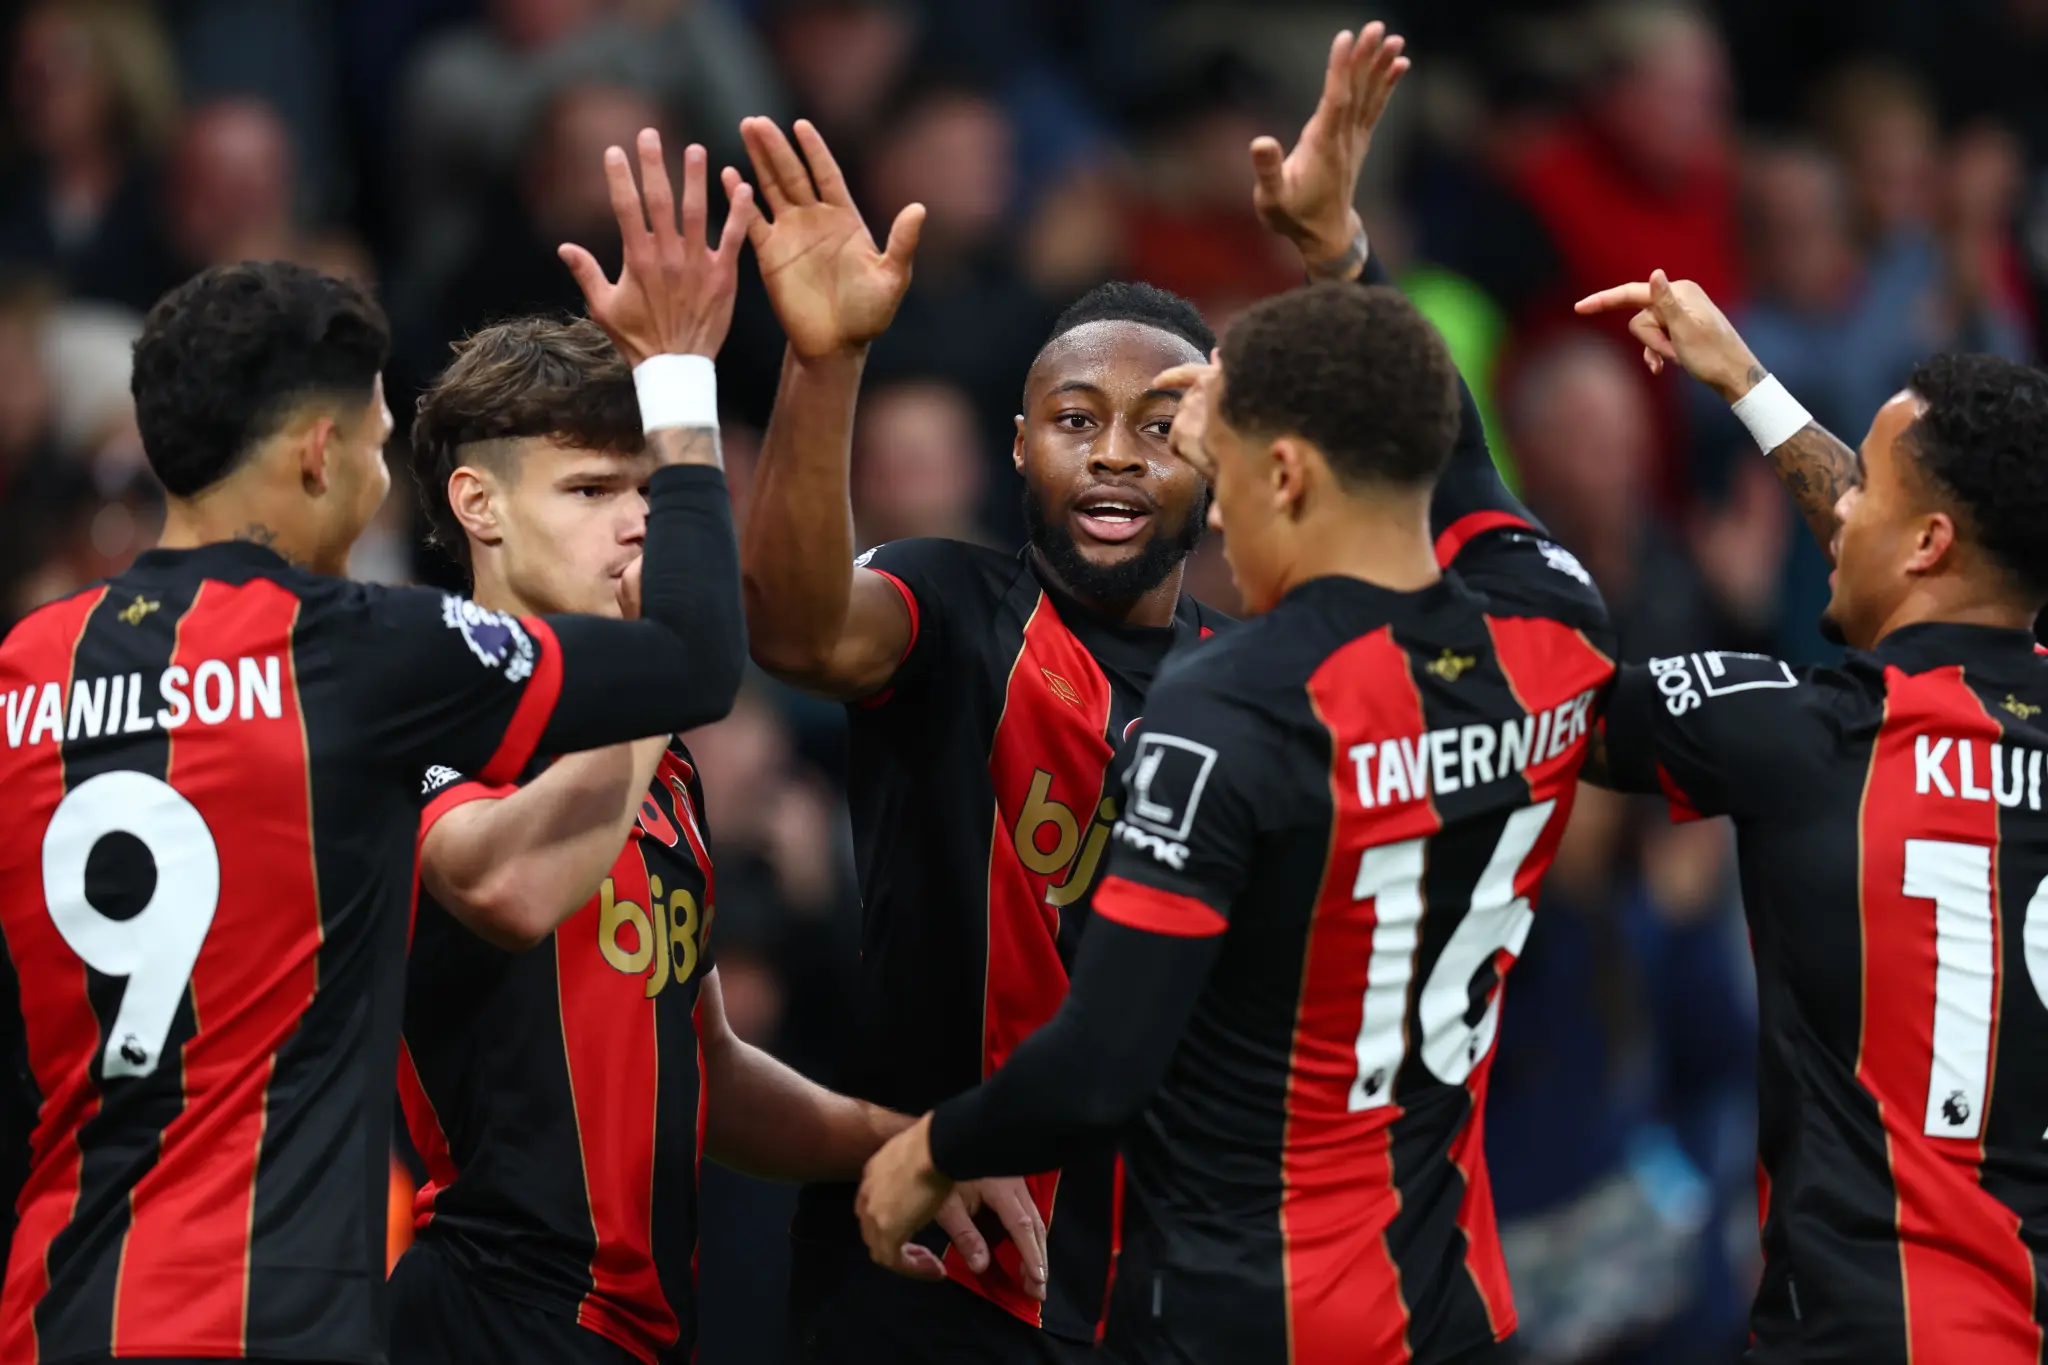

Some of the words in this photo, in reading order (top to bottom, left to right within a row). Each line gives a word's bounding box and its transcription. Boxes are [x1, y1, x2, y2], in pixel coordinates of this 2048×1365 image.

[0, 656, 282, 749] VANILSON
[1348, 688, 1596, 808] TAVERNIER
[1914, 734, 2048, 811] KLUI
[1014, 766, 1119, 908] bj
[42, 770, 220, 1078] 9
[1347, 797, 1557, 1113] 16
[1902, 838, 2048, 1140] 1
